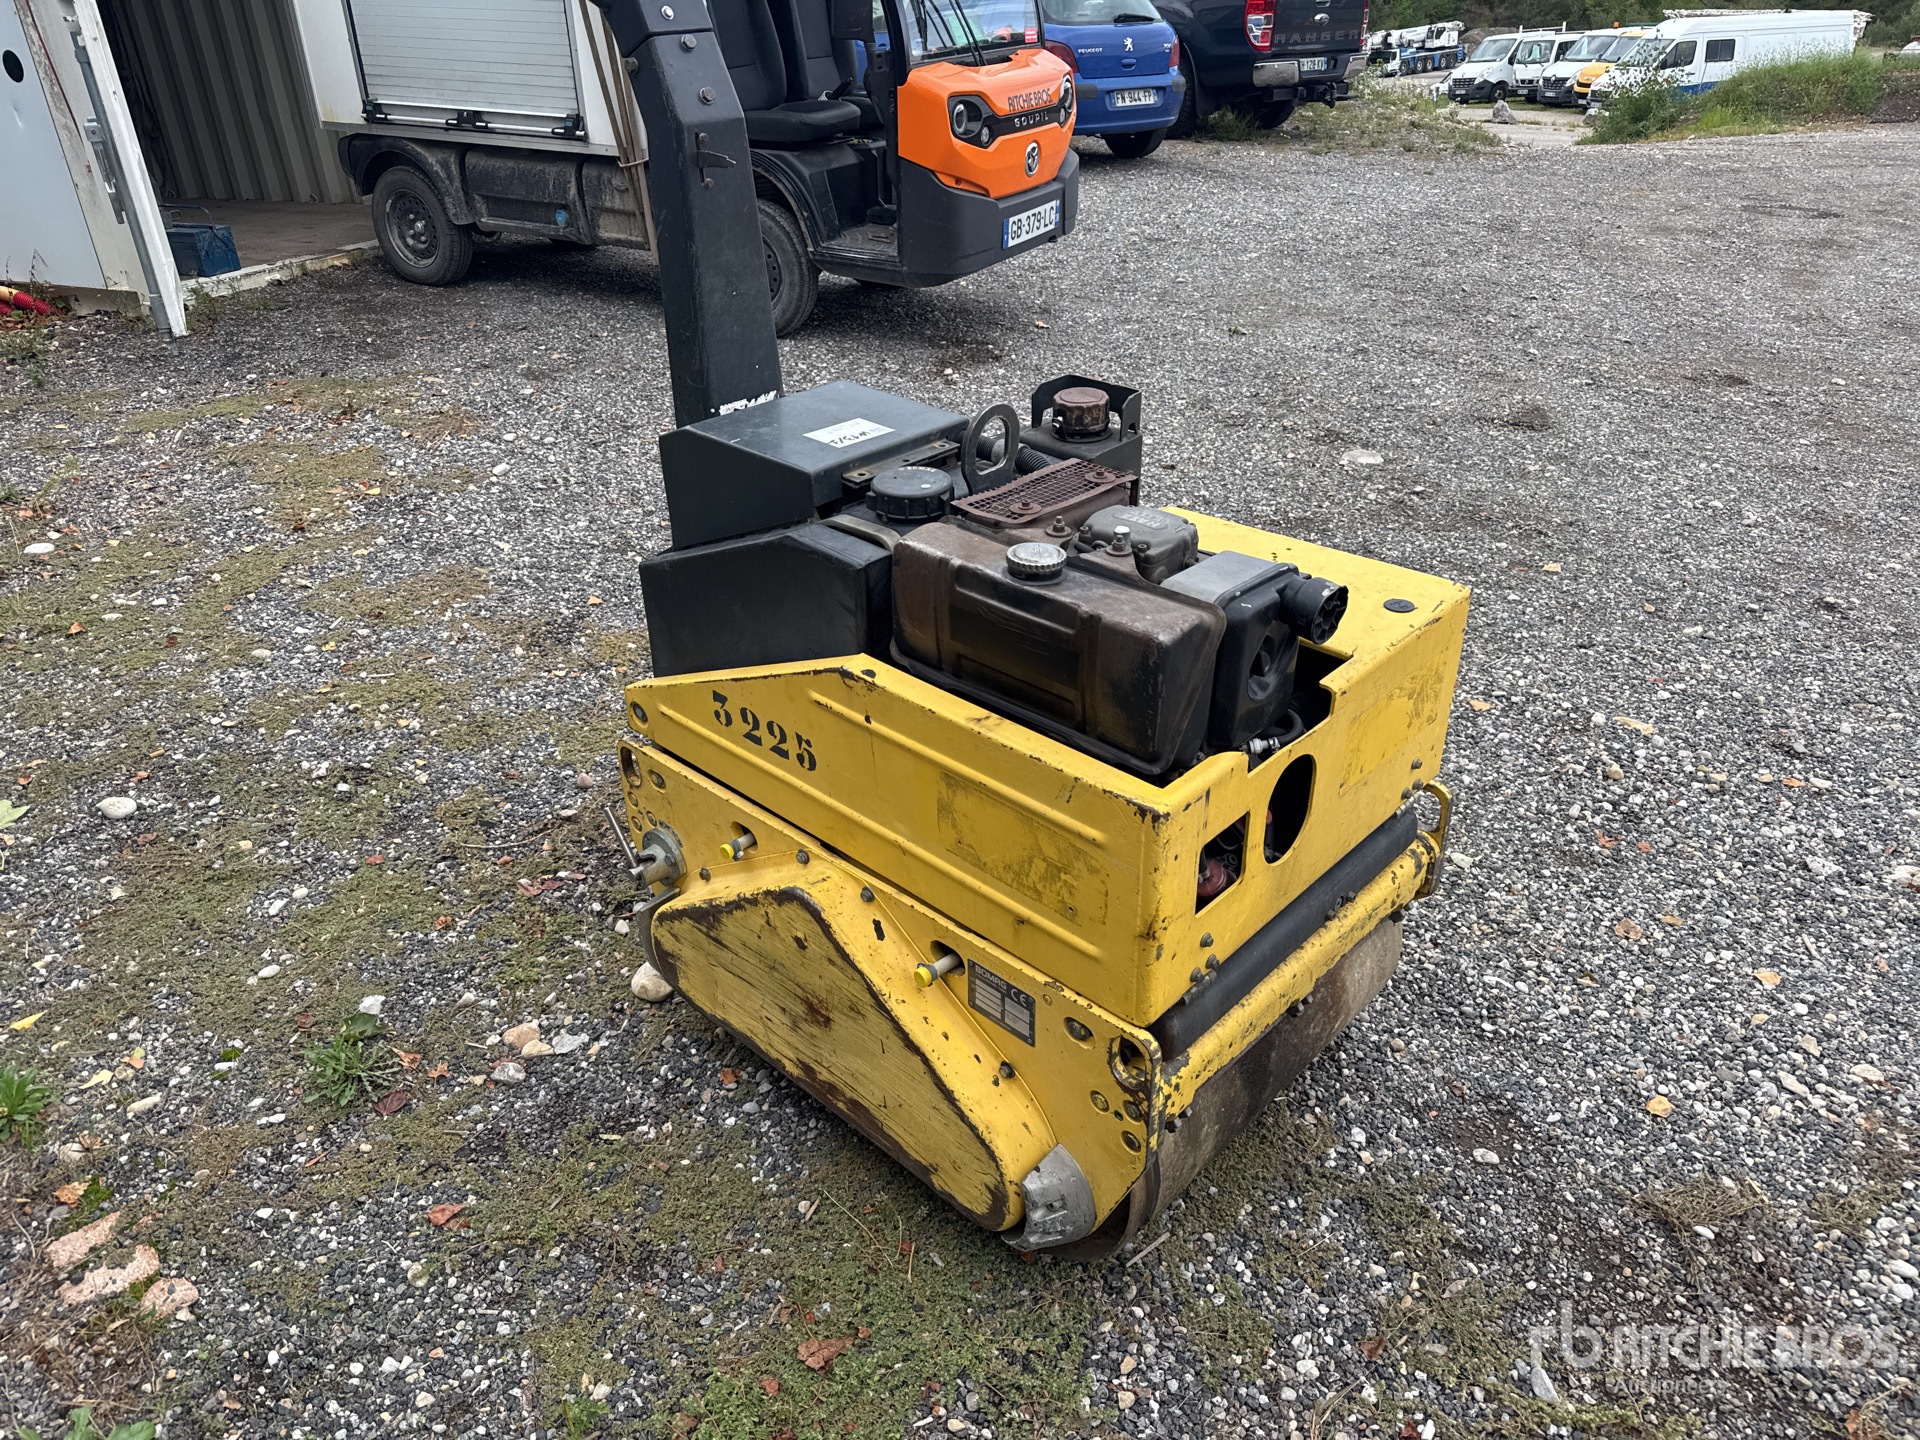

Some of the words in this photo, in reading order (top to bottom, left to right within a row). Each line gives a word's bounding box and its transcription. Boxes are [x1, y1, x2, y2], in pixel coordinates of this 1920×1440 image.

[1274, 29, 1360, 44] RANGER
[1007, 92, 1034, 112] RITCHIE
[1115, 90, 1152, 105] FN-944-FP
[1014, 111, 1049, 128] GOUPIL
[1010, 205, 1055, 241] GB-379-LC
[711, 689, 817, 772] 3225
[974, 964, 1007, 990] BOMAG
